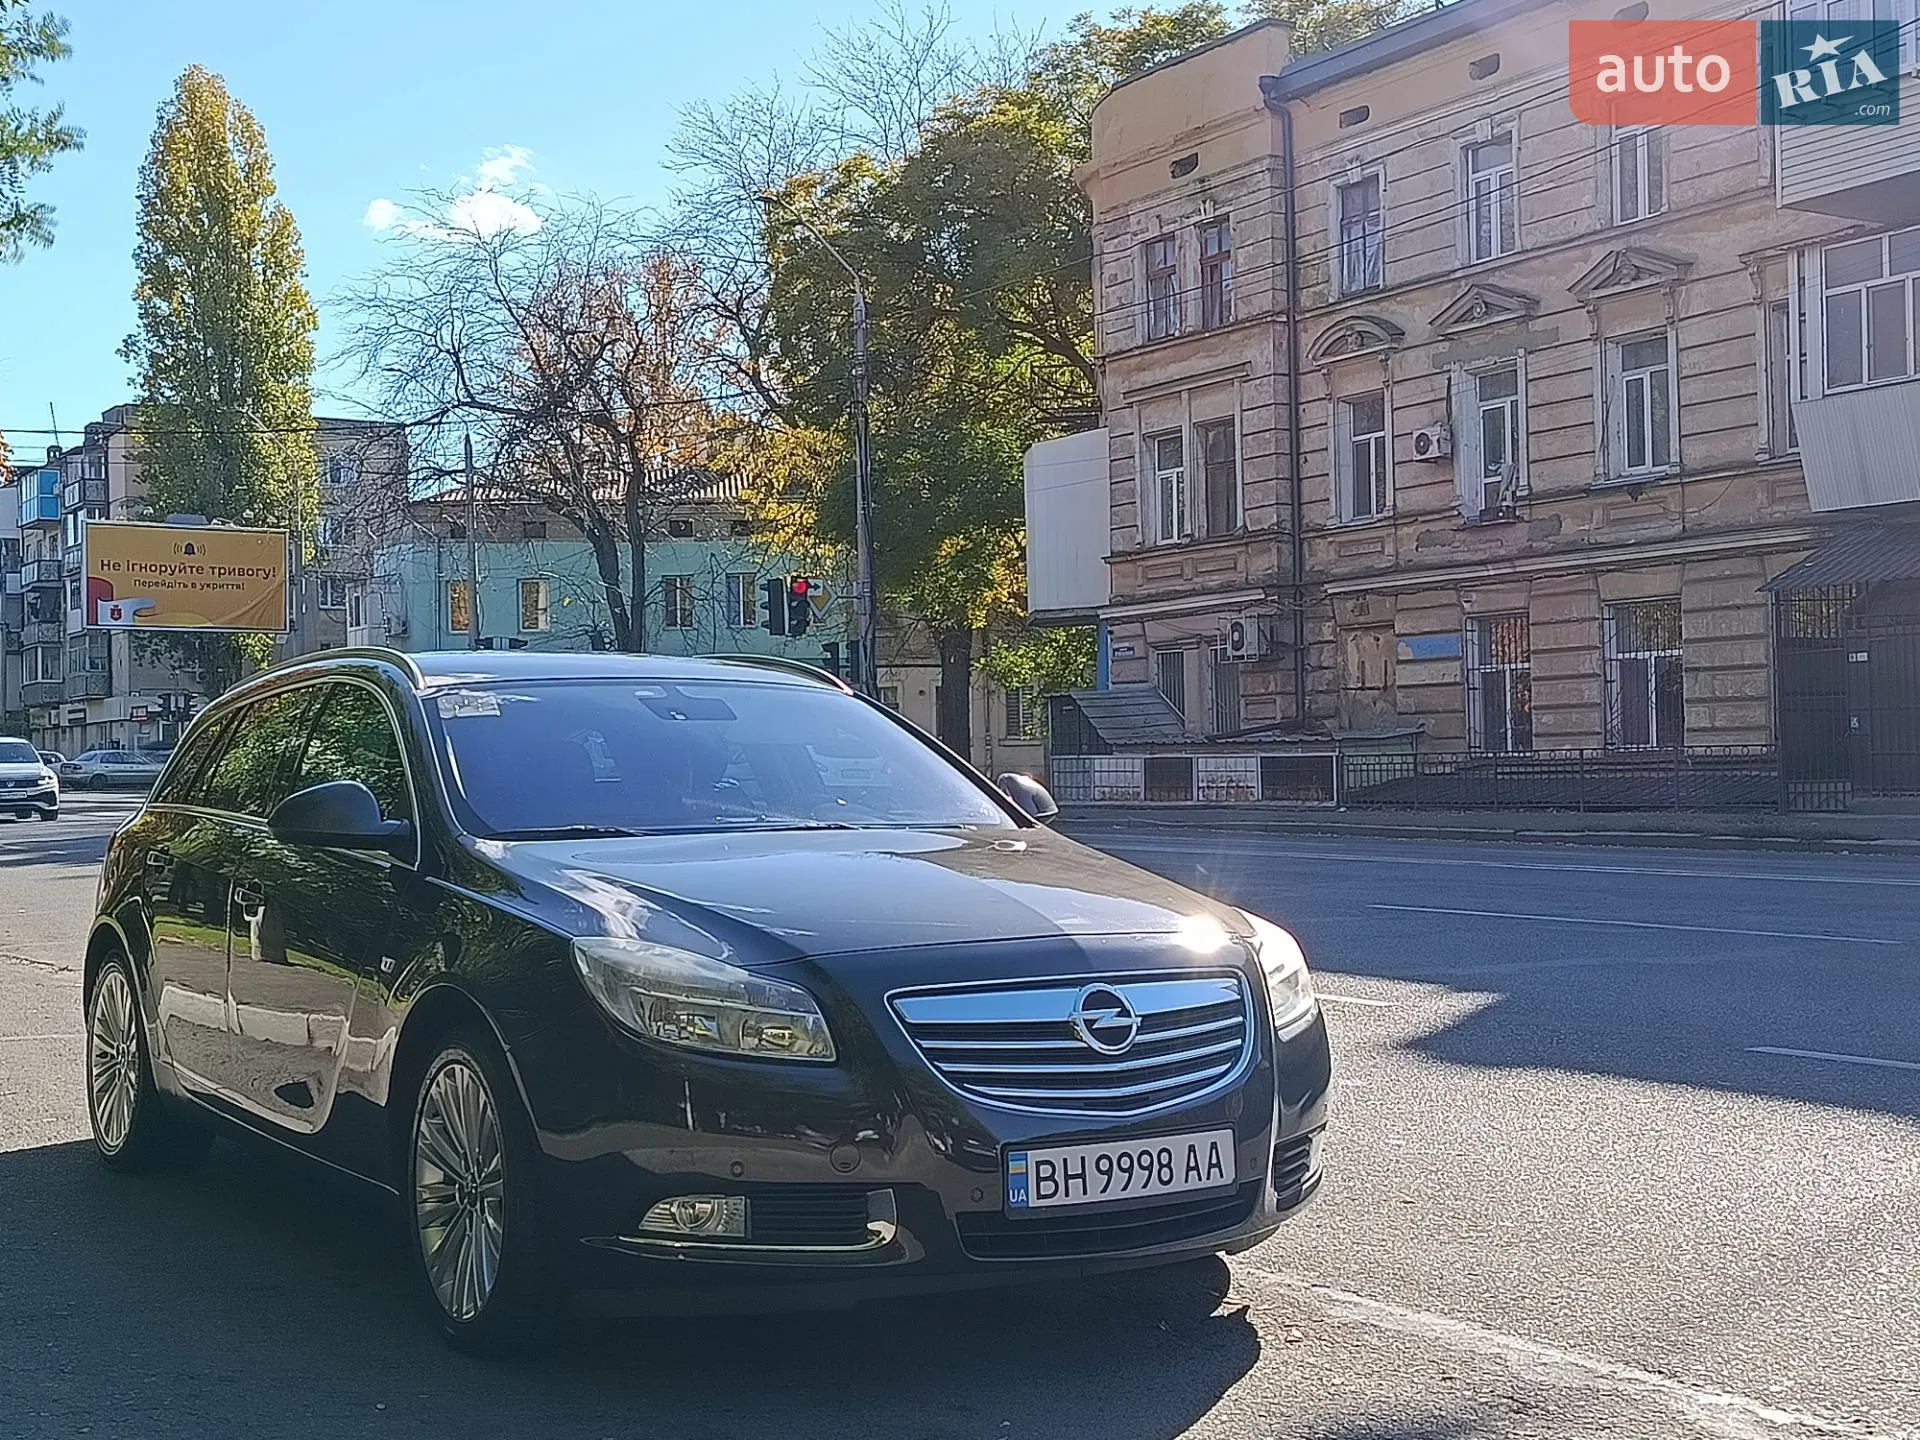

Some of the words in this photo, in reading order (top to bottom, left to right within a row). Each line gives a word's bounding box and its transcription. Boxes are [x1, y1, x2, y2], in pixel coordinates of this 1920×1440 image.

[100, 559, 121, 572] Не
[209, 565, 276, 580] тривогу!
[133, 579, 189, 590] Перейдіть
[199, 582, 245, 591] укриття!
[1034, 1155, 1088, 1201] BH
[1094, 1146, 1174, 1195] 9998
[1184, 1140, 1225, 1184] AA
[1009, 1188, 1027, 1203] UA
